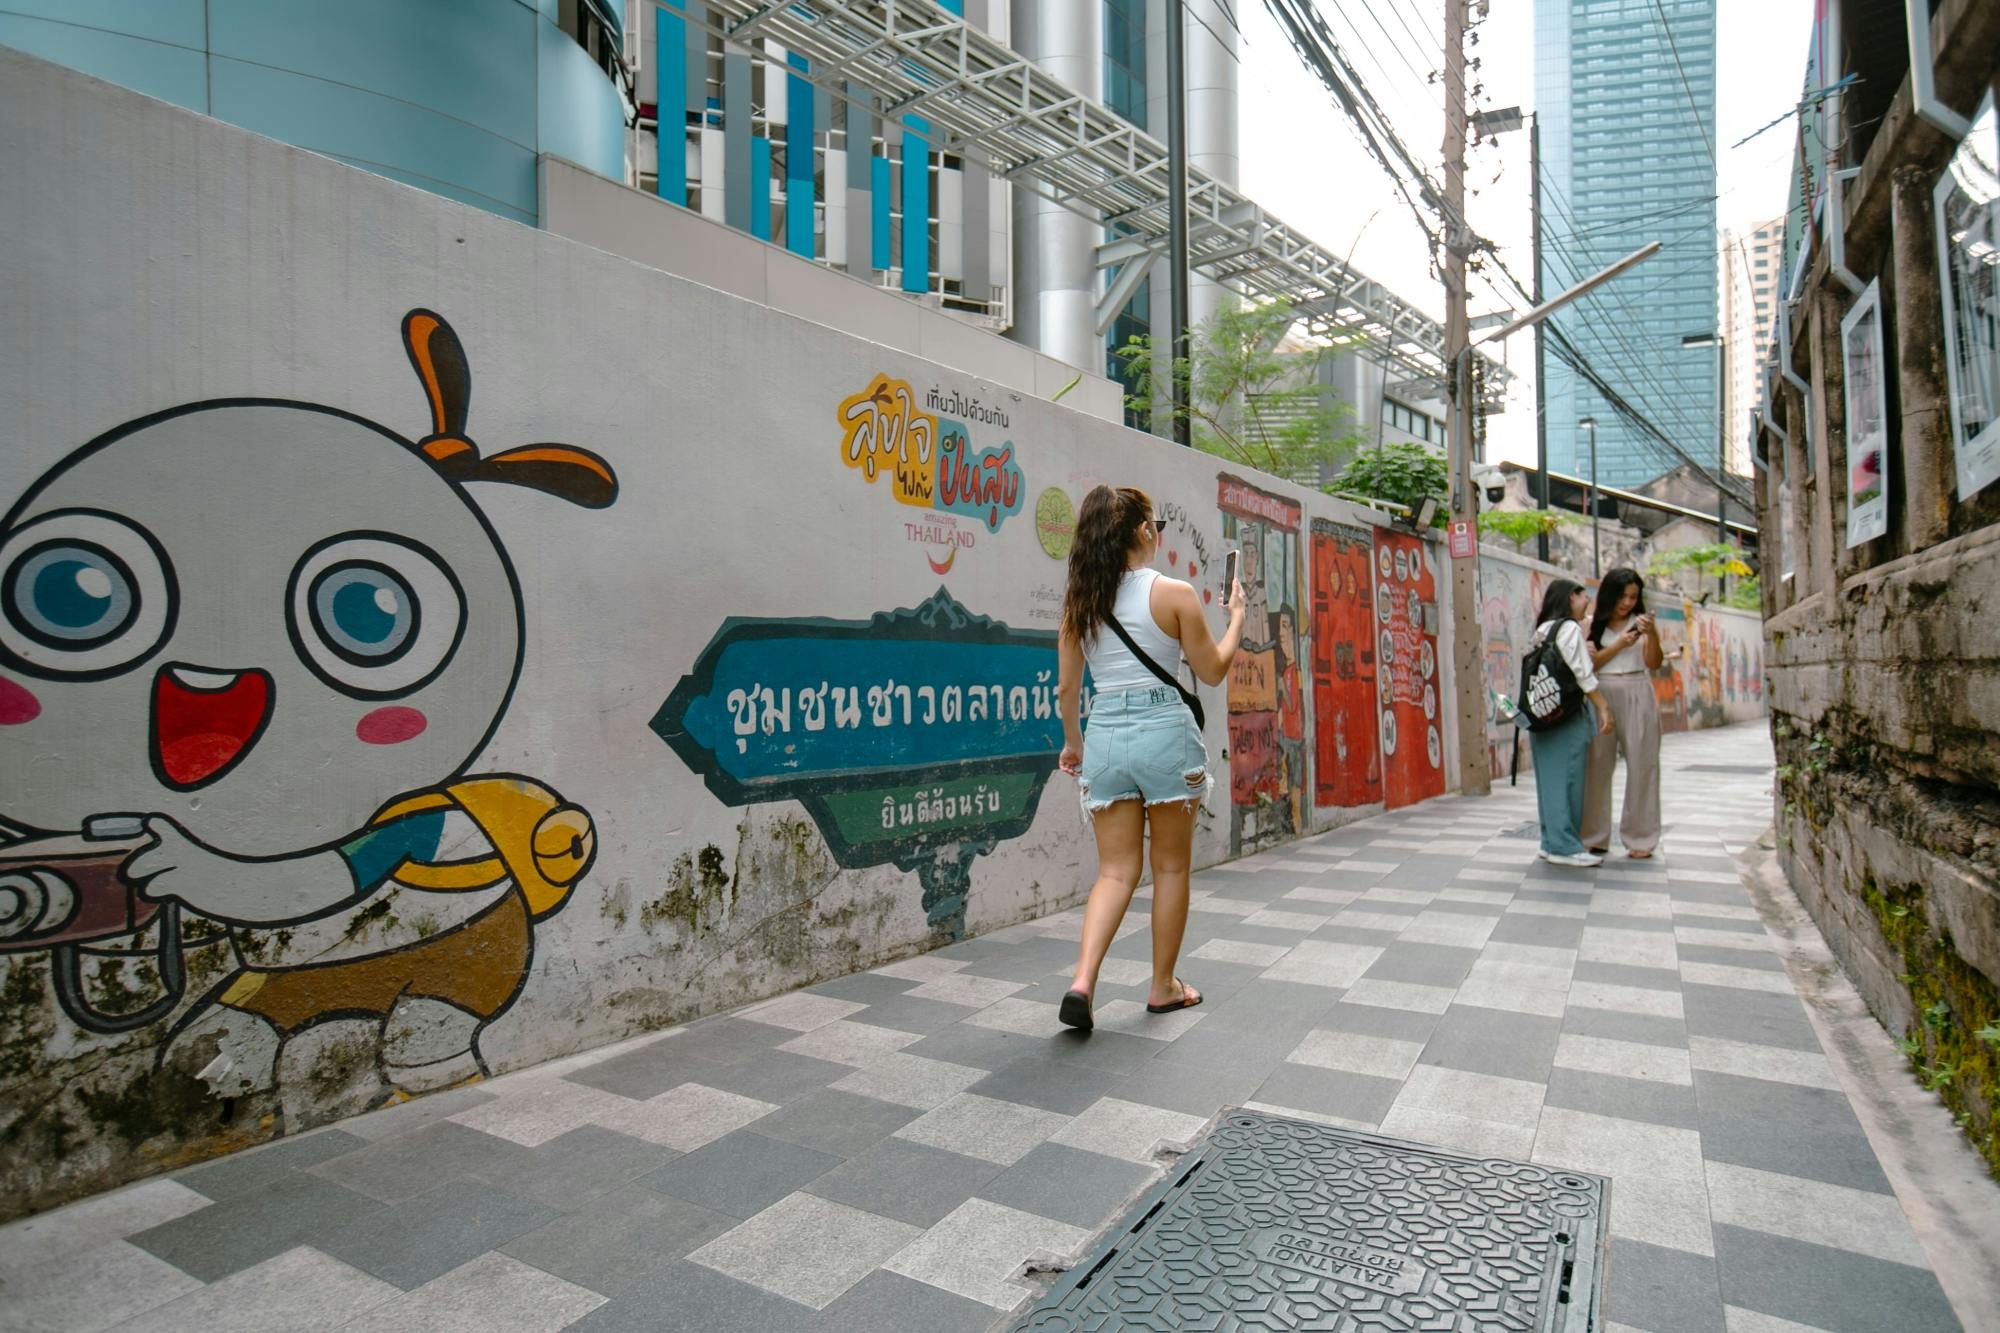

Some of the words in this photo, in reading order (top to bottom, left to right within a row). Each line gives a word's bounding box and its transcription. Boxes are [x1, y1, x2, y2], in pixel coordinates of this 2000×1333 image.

[926, 383, 1009, 429] เที่ยวไปด้วยกัน
[904, 522, 976, 549] THAILAND
[1159, 502, 1188, 534] very
[881, 783, 1000, 829] ยินดีต้อนรับ
[1266, 1246, 1395, 1290] TALATNOI
